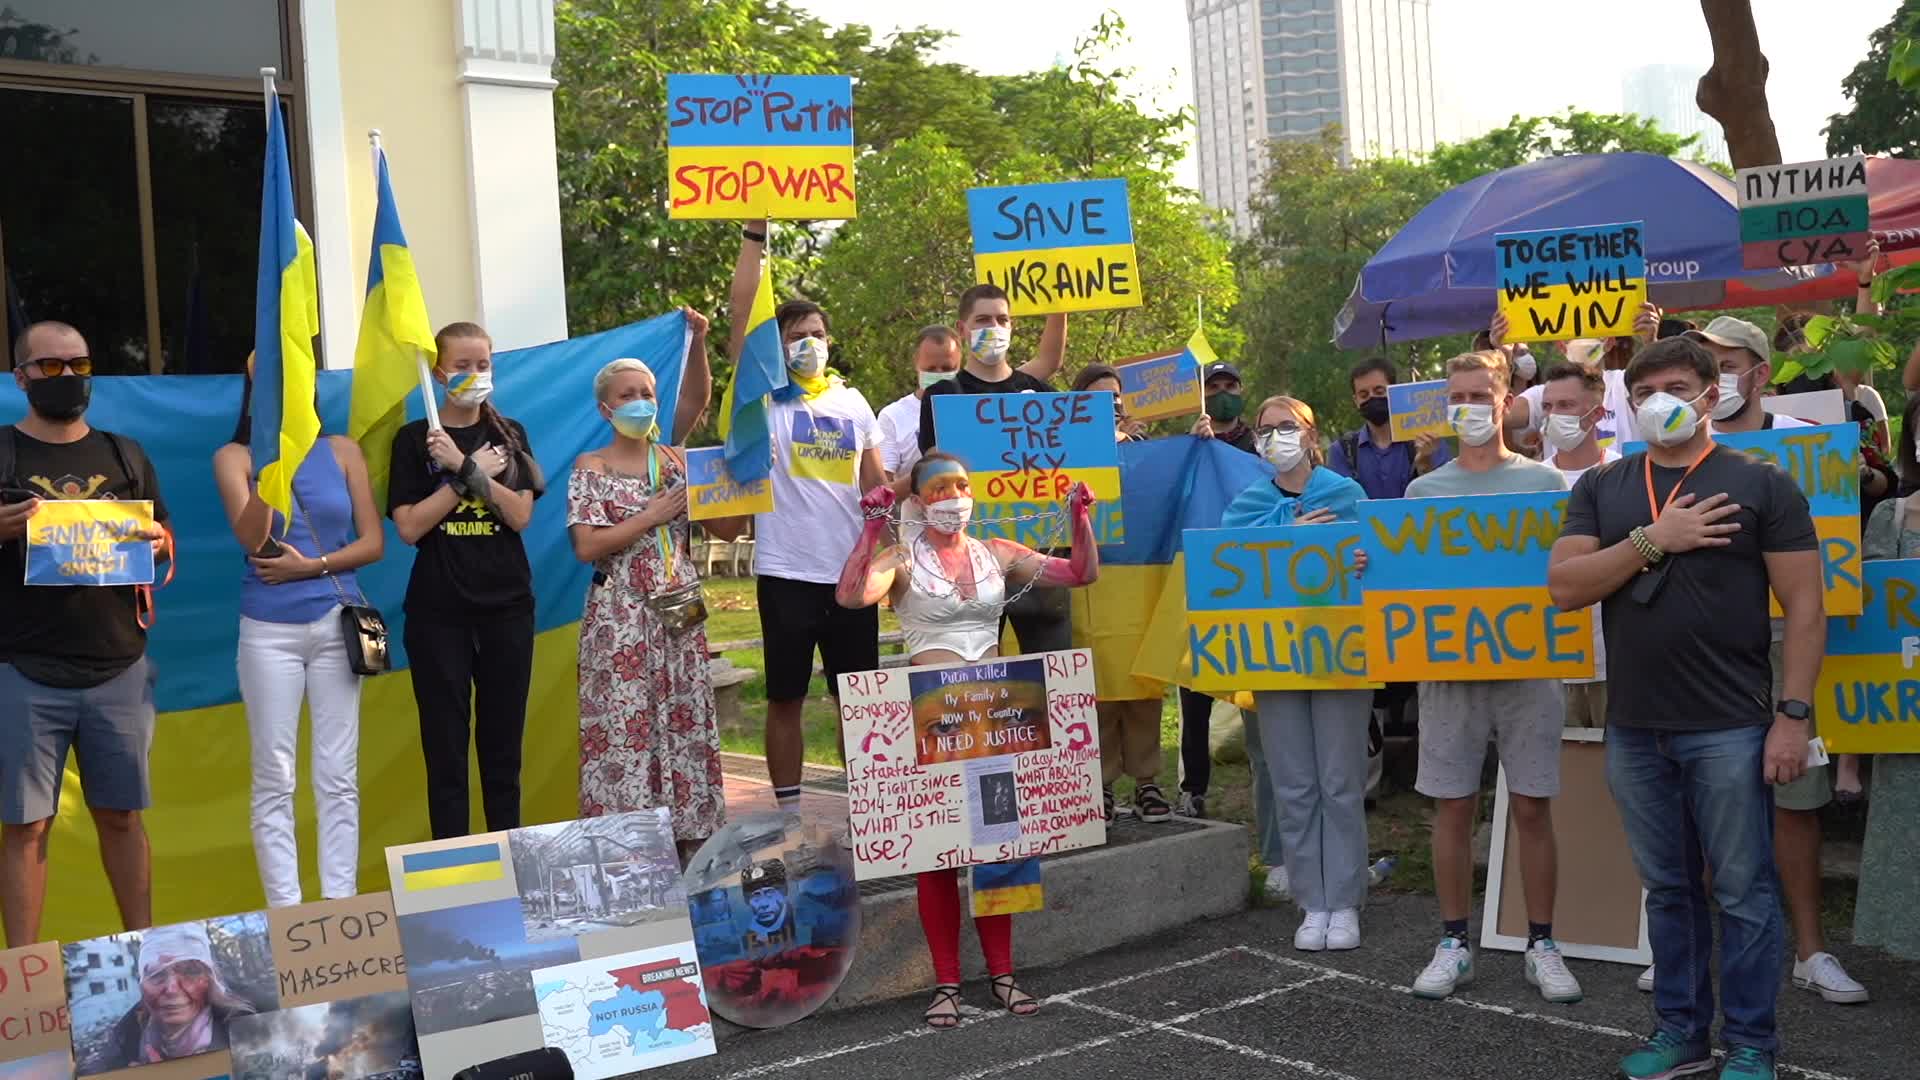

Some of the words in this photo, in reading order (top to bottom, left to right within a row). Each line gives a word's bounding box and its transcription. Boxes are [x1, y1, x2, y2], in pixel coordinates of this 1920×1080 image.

[671, 96, 752, 127] STOP
[673, 161, 764, 208] STOP
[767, 163, 854, 202] WAR
[1746, 162, 1866, 200] ПУТИНА
[992, 195, 1107, 242] SAVE
[1776, 207, 1849, 233] ПОД
[1496, 227, 1642, 268] TOGETHER
[1777, 237, 1853, 264] СУД
[986, 257, 1131, 305] UKRAINE
[1504, 271, 1551, 302] WE
[1565, 264, 1637, 297] WILL
[1529, 297, 1625, 336] WIN
[976, 394, 1092, 425] CLOSE
[798, 447, 852, 460] UKRAINE
[1001, 451, 1067, 478] SKY
[987, 474, 1072, 499] OVER
[1210, 535, 1361, 600] STOP
[1380, 603, 1585, 665] PEACE
[975, 662, 1008, 681] Killed
[1046, 653, 1088, 678] RIP
[846, 671, 889, 697] RIP
[1834, 679, 1920, 725] UKR
[921, 737, 928, 755] I
[937, 733, 974, 752] NEED
[983, 725, 1037, 748] JUSTICE
[848, 758, 858, 783] I
[286, 911, 388, 952] STOP
[279, 955, 407, 997] MASSACRE
[675, 964, 696, 978] NEWS
[595, 1008, 618, 1022] NOT
[619, 1001, 659, 1018] RUSSIA
